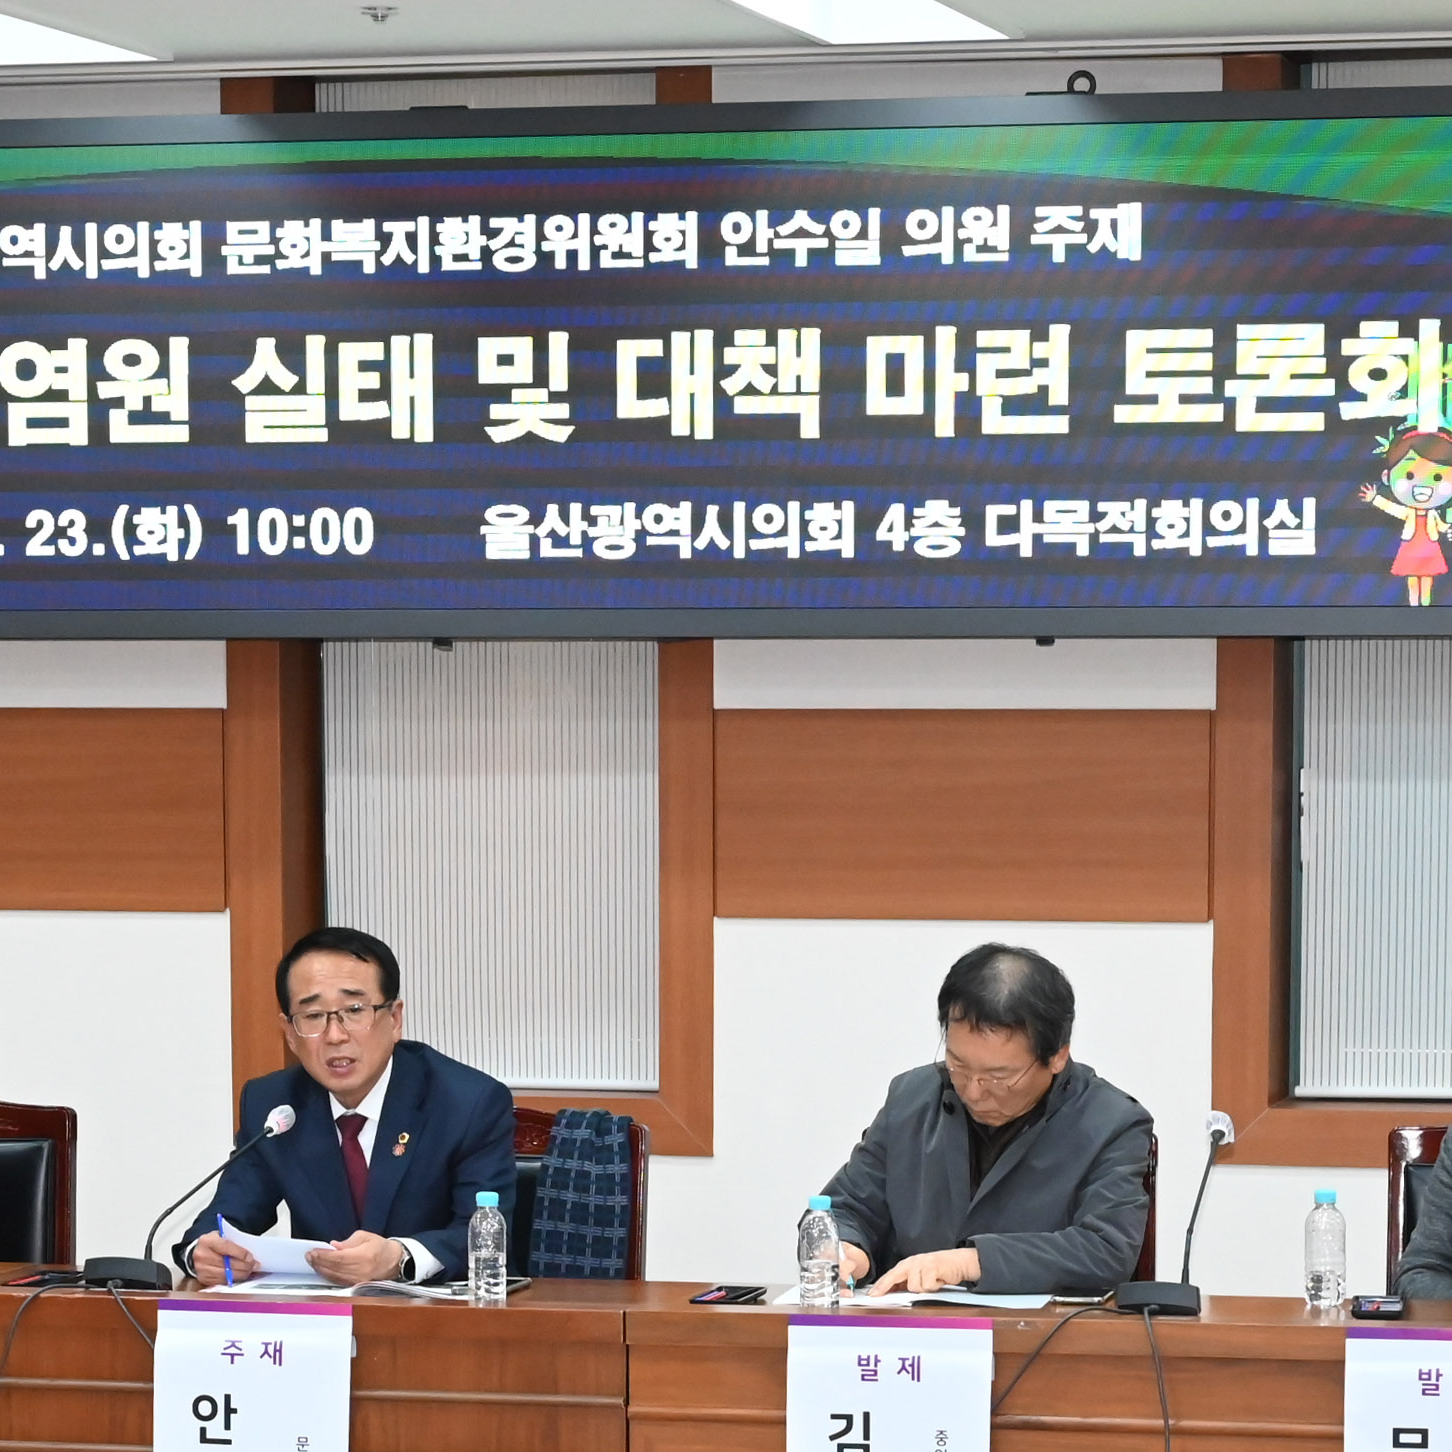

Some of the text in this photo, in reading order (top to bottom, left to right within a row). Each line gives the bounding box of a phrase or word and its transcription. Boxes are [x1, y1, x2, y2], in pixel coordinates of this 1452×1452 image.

[220, 210, 699, 276] 문화복지환경위원회
[720, 207, 882, 267] 안수일
[900, 204, 1011, 265] 의원
[1030, 201, 1143, 263] 주재
[231, 332, 434, 444] 실태
[477, 331, 576, 444] 및
[616, 327, 822, 440] 대책
[865, 323, 1072, 438] 마련
[1113, 318, 1441, 434] 토론회
[25, 503, 203, 562] 23.(화)
[226, 506, 374, 556] 10:00
[479, 496, 1317, 560] 울산광역시의회 4층 다목적회의실
[220, 1340, 283, 1367] 주재
[857, 1354, 921, 1383] 발제
